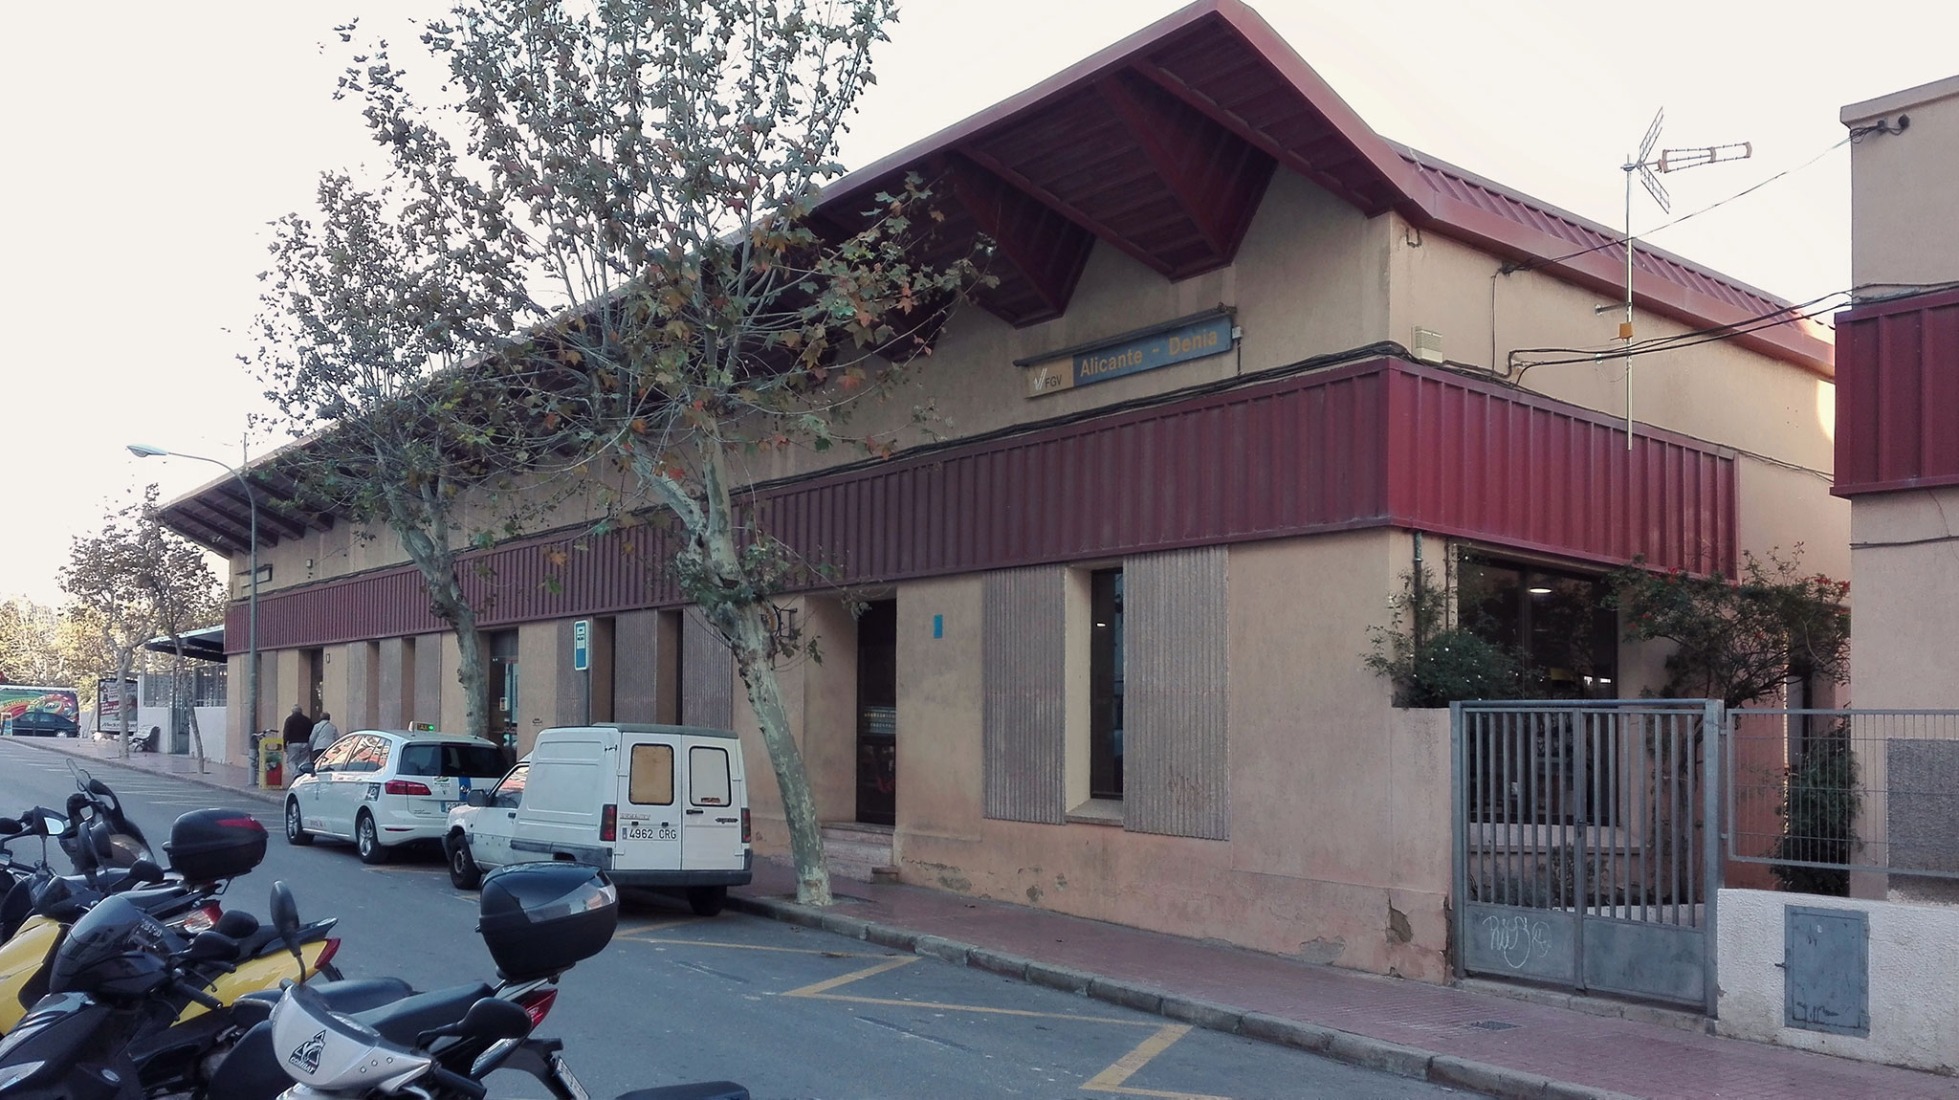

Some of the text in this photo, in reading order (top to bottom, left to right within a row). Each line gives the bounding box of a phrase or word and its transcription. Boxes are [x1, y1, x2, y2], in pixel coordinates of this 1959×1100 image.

[1080, 349, 1143, 377] Alicante
[1168, 329, 1217, 355] Denia
[1045, 374, 1062, 388] FGV
[629, 829, 677, 839] 4962 CRG
